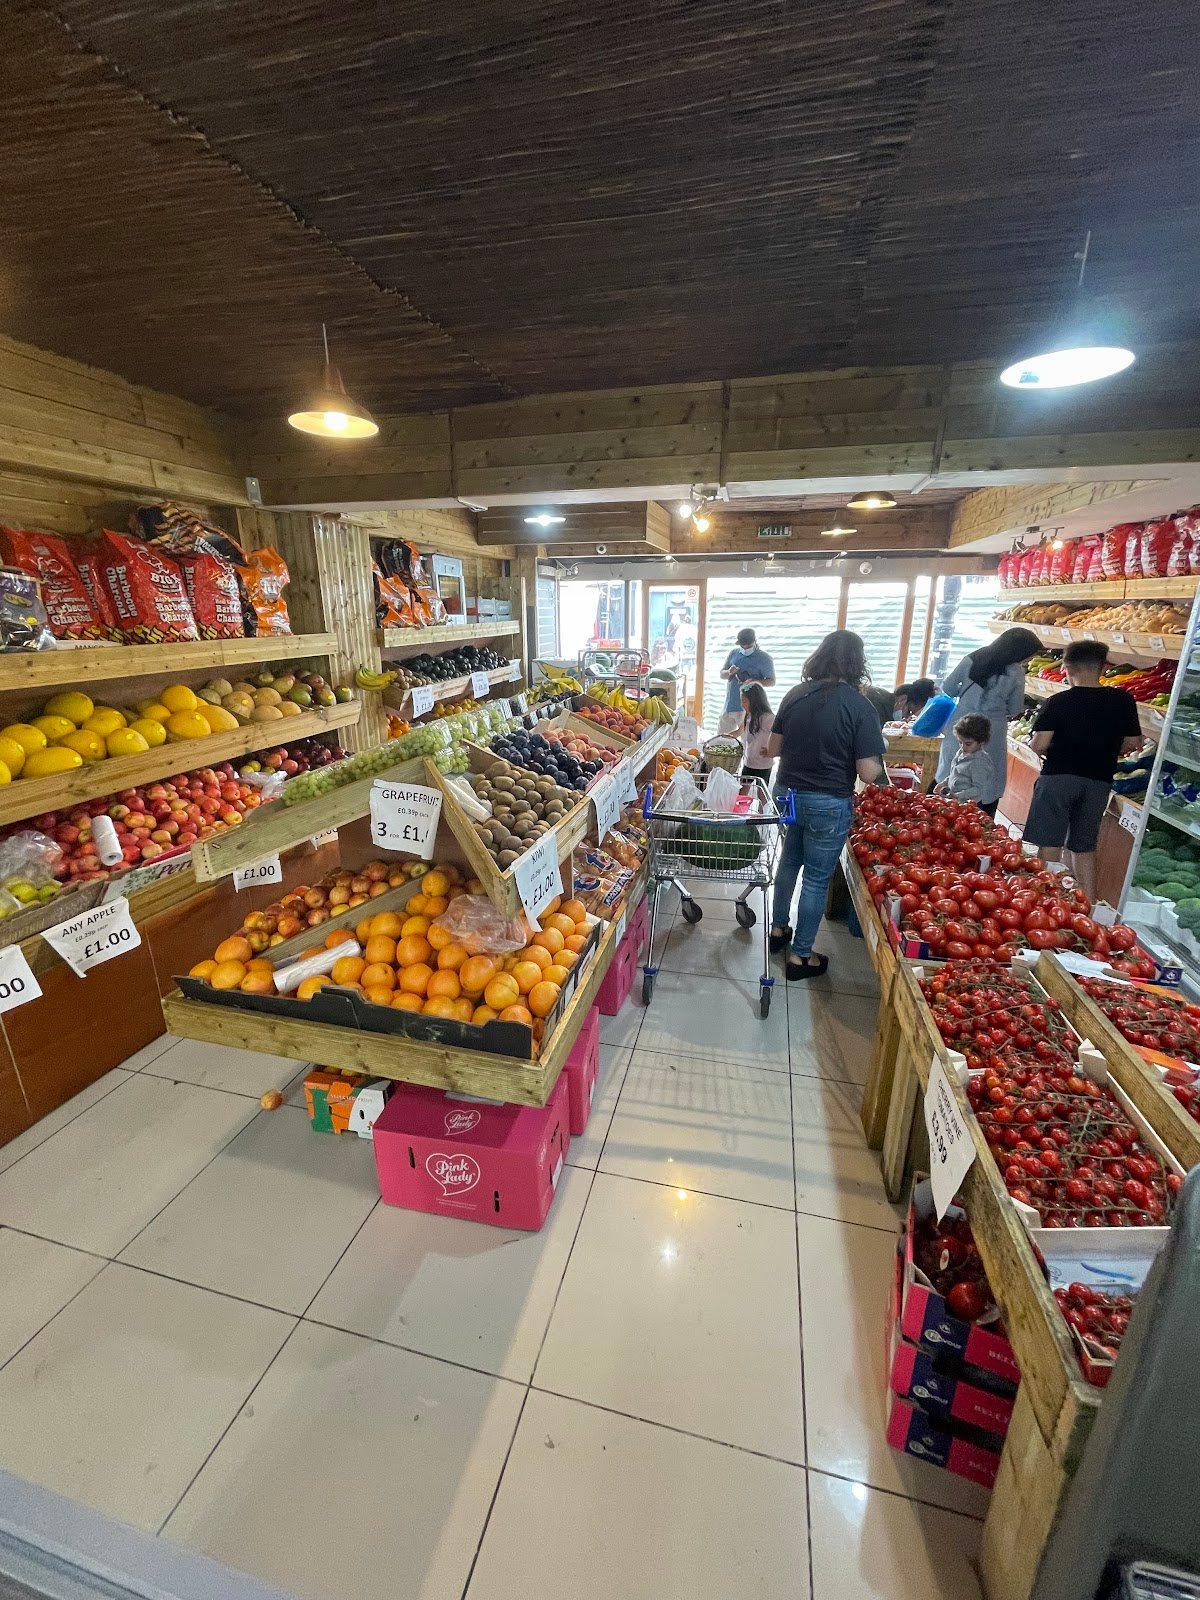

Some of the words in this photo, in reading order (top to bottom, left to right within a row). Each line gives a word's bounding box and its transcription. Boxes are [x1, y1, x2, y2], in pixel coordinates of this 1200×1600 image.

[382, 789, 440, 807] GRAPEFRUIT
[377, 821, 387, 837] 3
[243, 865, 275, 880] £1.00
[533, 871, 555, 907] £1.00
[61, 920, 84, 938] ANY
[86, 905, 117, 927] APPLE
[84, 927, 131, 959] £1.00
[449, 1113, 474, 1123] Pink
[449, 1120, 474, 1129] Lady
[951, 1115, 963, 1141] VINE
[435, 1158, 470, 1175] Pink
[441, 1171, 474, 1185] Lady
